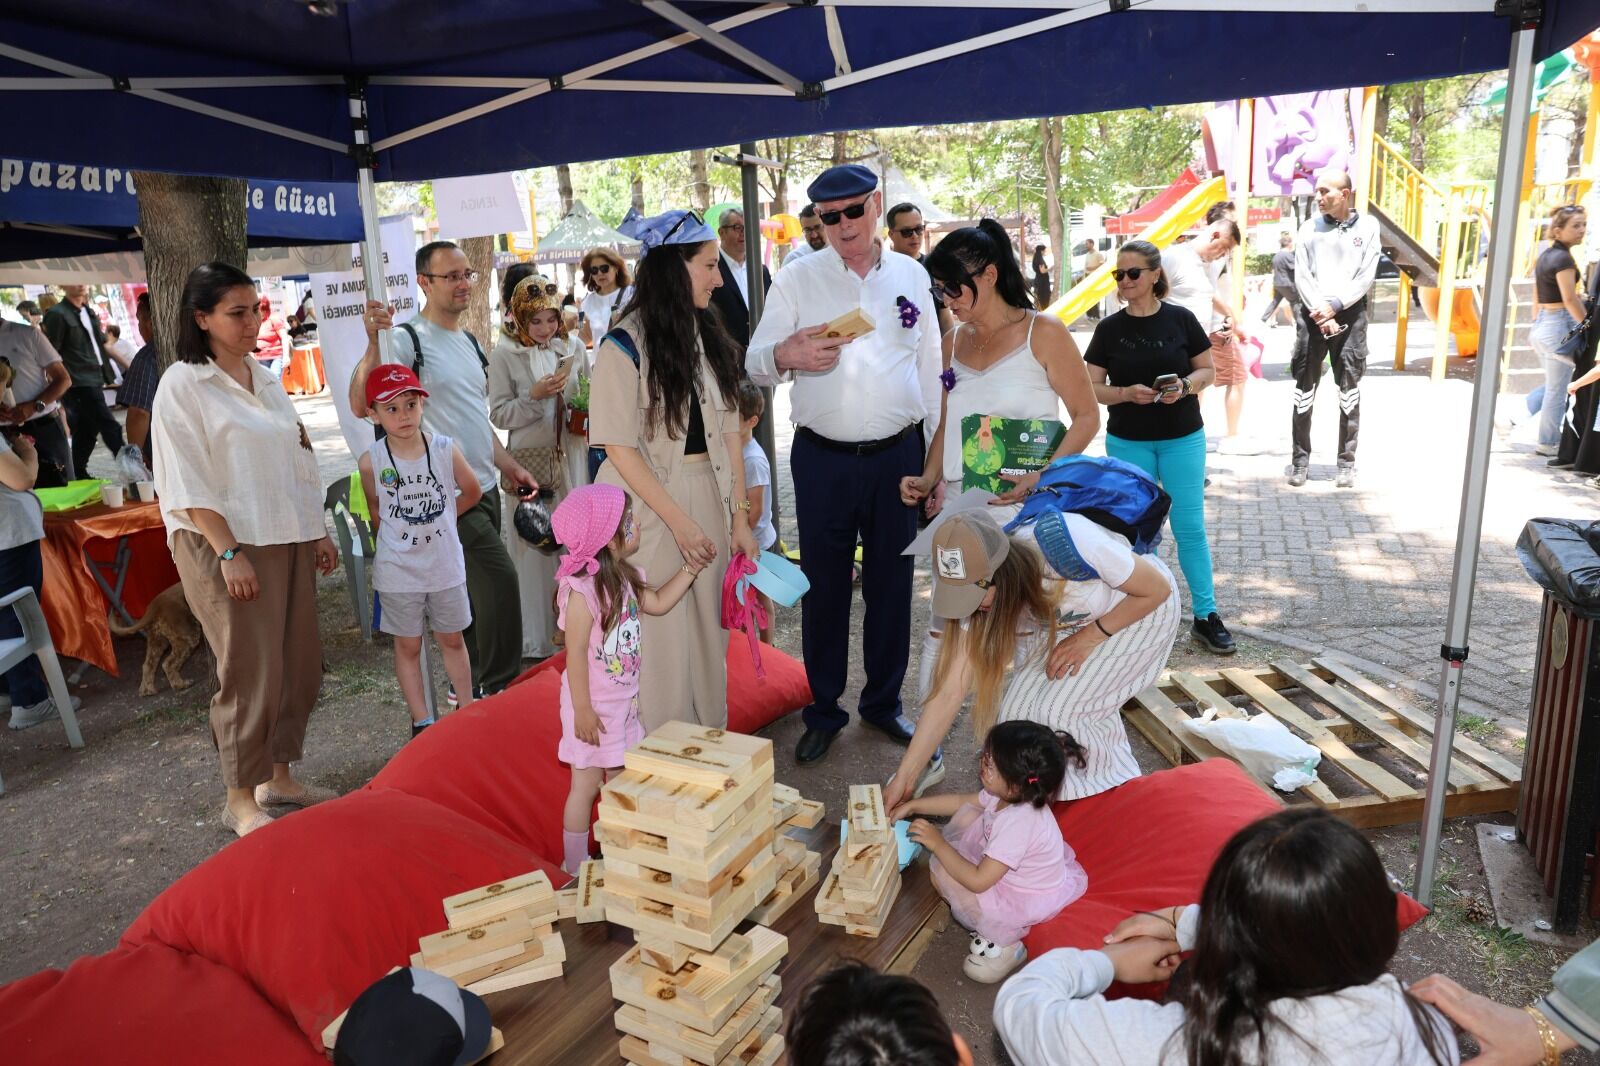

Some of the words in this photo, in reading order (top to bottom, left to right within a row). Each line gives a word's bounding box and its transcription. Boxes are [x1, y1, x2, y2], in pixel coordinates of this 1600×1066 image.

[275, 185, 336, 217] Güzel
[549, 249, 581, 260] Birlikte
[403, 491, 432, 501] ORIGINAL
[389, 503, 414, 518] New
